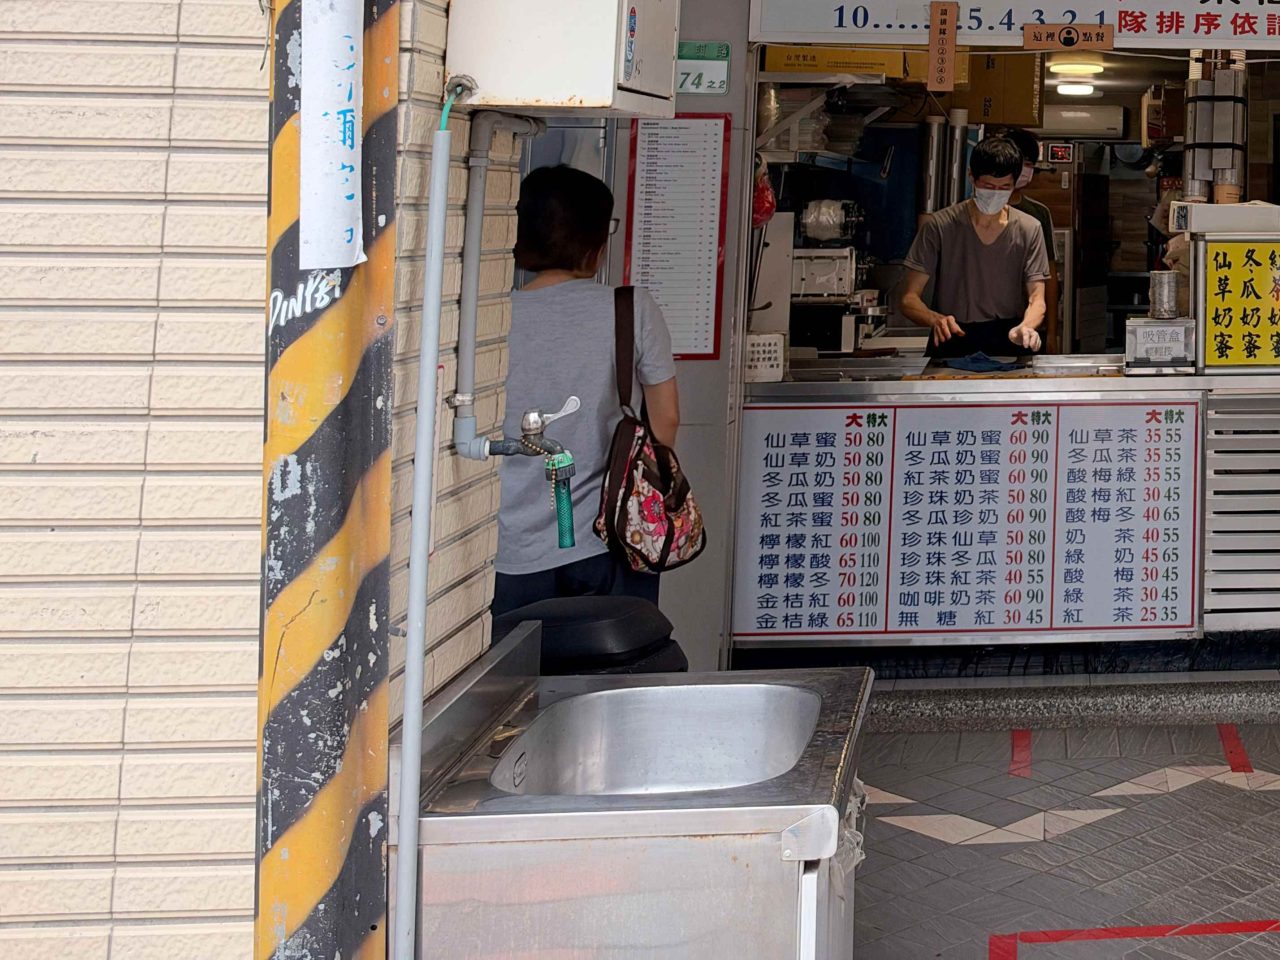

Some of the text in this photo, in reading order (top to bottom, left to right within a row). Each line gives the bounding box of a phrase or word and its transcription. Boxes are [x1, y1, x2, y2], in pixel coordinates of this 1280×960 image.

[1212, 251, 1234, 359] 仙草奶蜜
[1239, 248, 1263, 359] 冬瓜奶蜜
[845, 412, 888, 428] 大 特大
[1011, 410, 1051, 425] 大 特大
[1145, 409, 1184, 424] 大 特大
[845, 432, 862, 447] 50
[867, 432, 884, 446] 80
[1010, 430, 1027, 444] 60
[1032, 430, 1049, 444] 90
[1145, 429, 1161, 443] 35
[1166, 429, 1181, 442] 55
[844, 452, 861, 467] 50
[866, 452, 883, 466] 80
[1009, 450, 1026, 464] 60
[1032, 449, 1048, 463] 90
[1145, 448, 1160, 462] 35
[1165, 448, 1181, 462] 55
[843, 472, 860, 486] 50
[865, 471, 882, 486] 80
[1009, 470, 1025, 483] 60
[1031, 469, 1047, 483] 90
[1144, 467, 1160, 481] 35
[1165, 467, 1180, 481] 55
[842, 492, 859, 506] 50
[864, 491, 881, 506] 80
[1008, 489, 1025, 504] 50
[1030, 489, 1047, 503] 80
[1144, 487, 1160, 501] 30
[1164, 487, 1180, 501] 45
[841, 512, 858, 526] 50
[864, 511, 881, 526] 80
[1007, 509, 1024, 523] 60
[1029, 509, 1046, 523] 90
[1143, 507, 1159, 521] 40
[1164, 507, 1179, 521] 65
[840, 533, 857, 547] 60
[862, 532, 880, 547] 100
[1007, 531, 1023, 545] 50
[1029, 530, 1045, 545] 80
[1143, 528, 1159, 542] 40
[1163, 528, 1179, 542] 55
[839, 553, 856, 568] 65
[861, 553, 879, 567] 110
[1006, 550, 1023, 565] 50
[1028, 550, 1045, 564] 80
[1142, 548, 1158, 562] 45
[1163, 548, 1178, 562] 65
[839, 572, 856, 587] 70
[860, 572, 878, 587] 120
[1005, 570, 1022, 584] 40
[1028, 569, 1044, 584] 55
[1142, 567, 1158, 581] 30
[1162, 567, 1178, 581] 45
[838, 592, 855, 607] 60
[860, 592, 878, 606] 100
[1004, 590, 1021, 604] 60
[1027, 589, 1044, 603] 90
[1141, 587, 1158, 601] 30
[1162, 586, 1178, 601] 45
[837, 613, 854, 627] 65
[859, 612, 877, 627] 110
[1004, 610, 1021, 624] 30
[1026, 609, 1042, 624] 45
[1141, 607, 1157, 621] 25
[1161, 607, 1177, 621] 35
